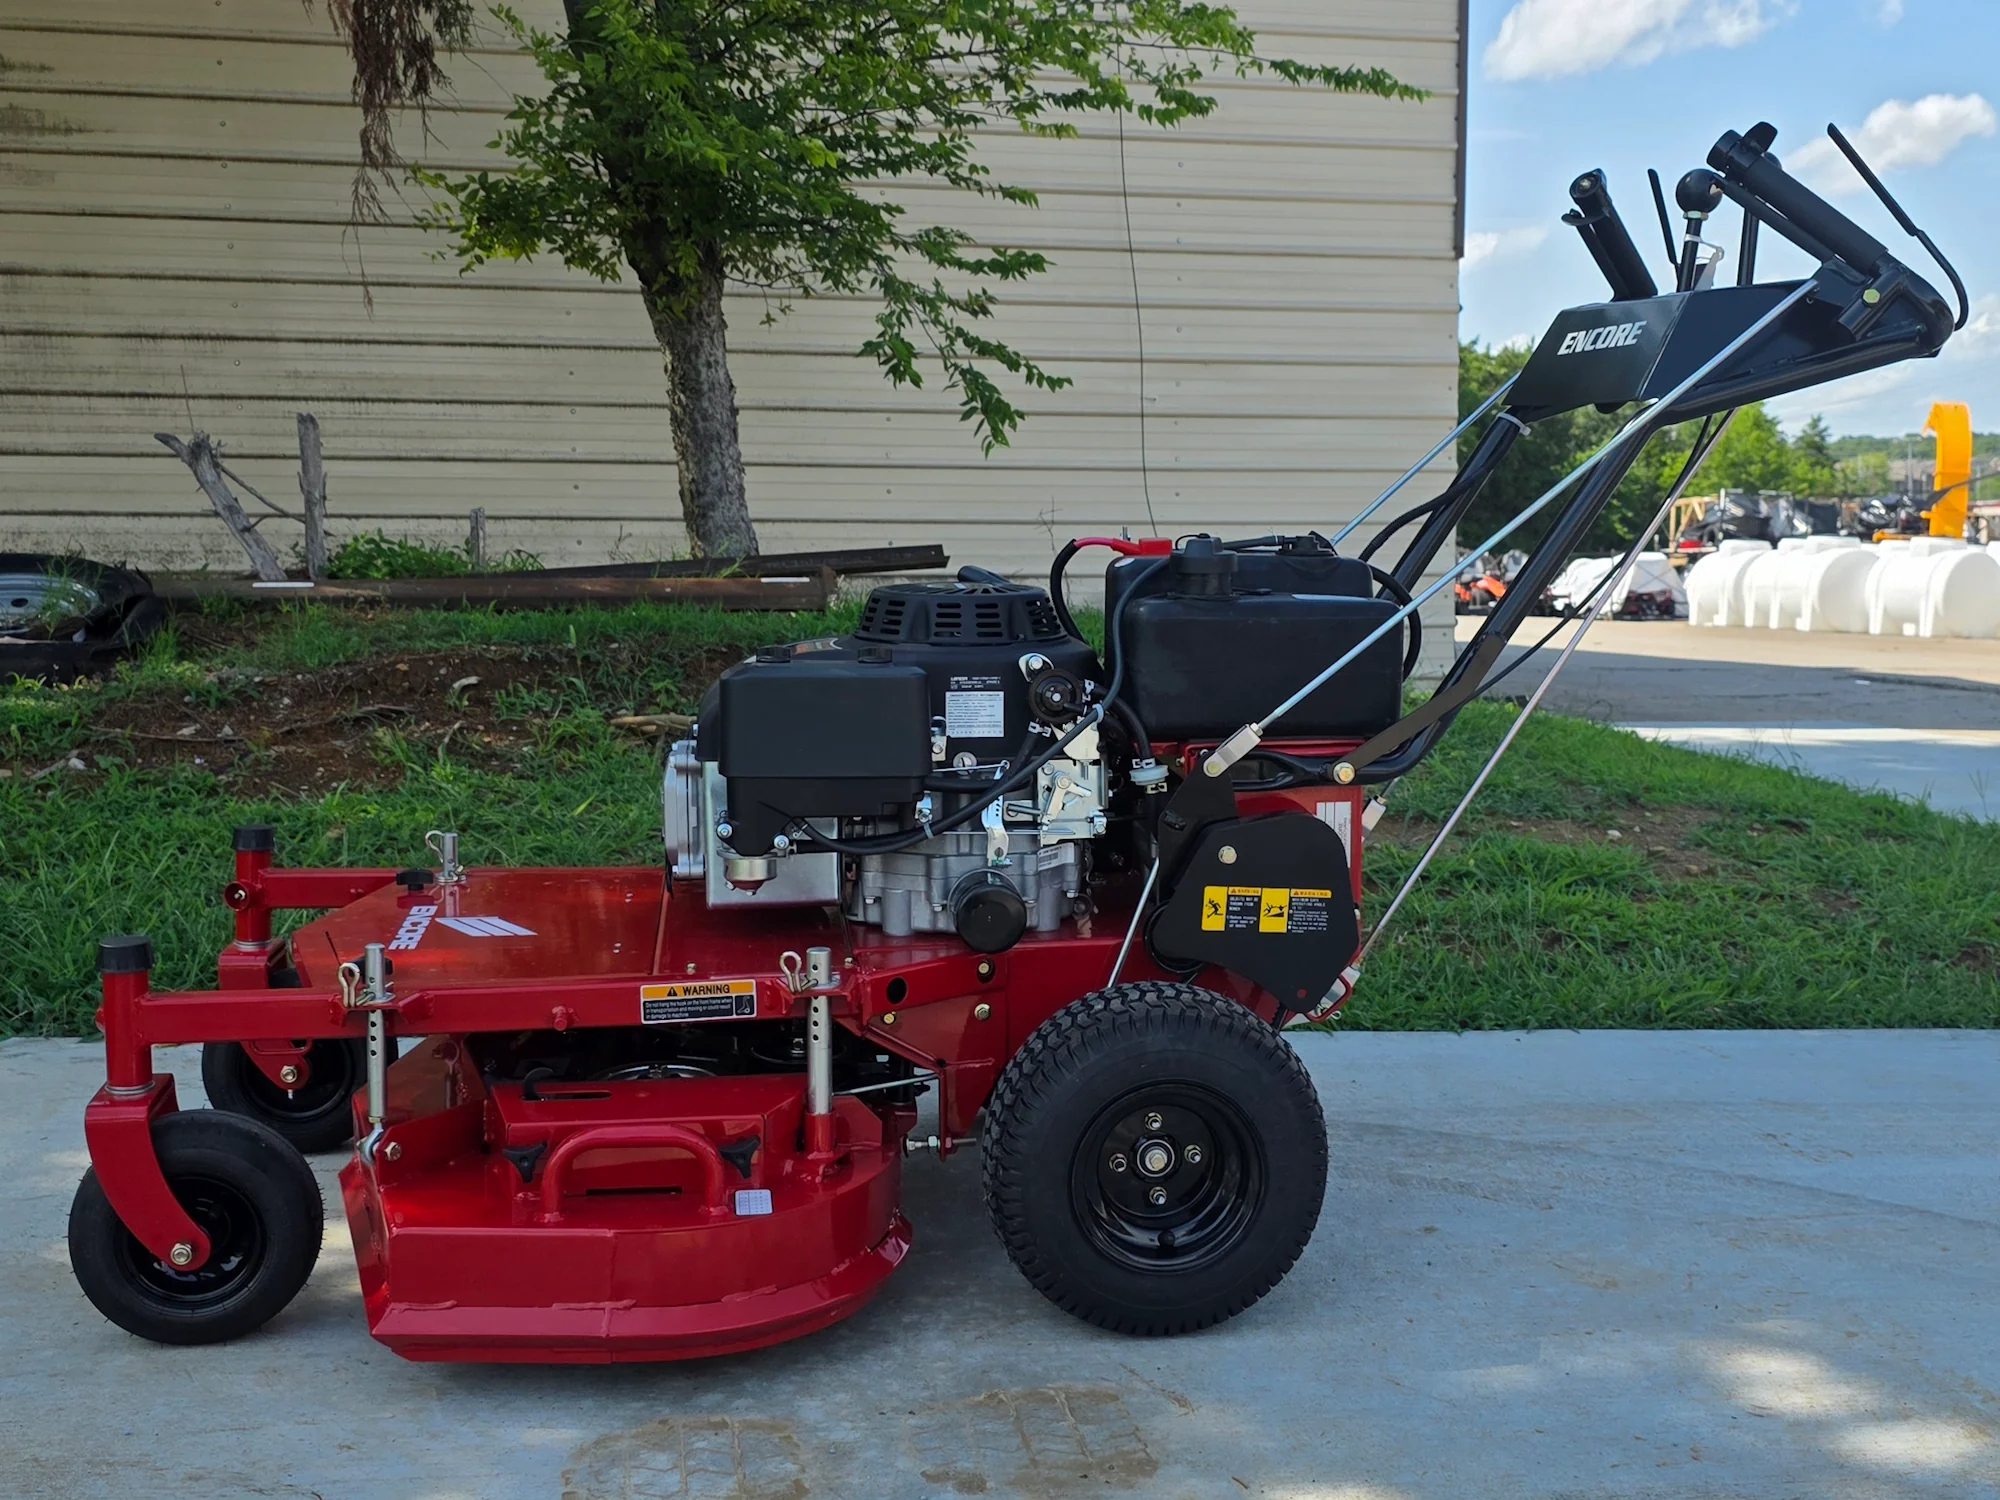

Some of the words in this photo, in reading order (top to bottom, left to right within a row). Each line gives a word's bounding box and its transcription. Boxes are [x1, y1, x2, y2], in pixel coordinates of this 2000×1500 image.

[1557, 320, 1647, 356] ENCORE
[388, 905, 439, 951] ENCORE
[682, 984, 731, 996] WARNING
